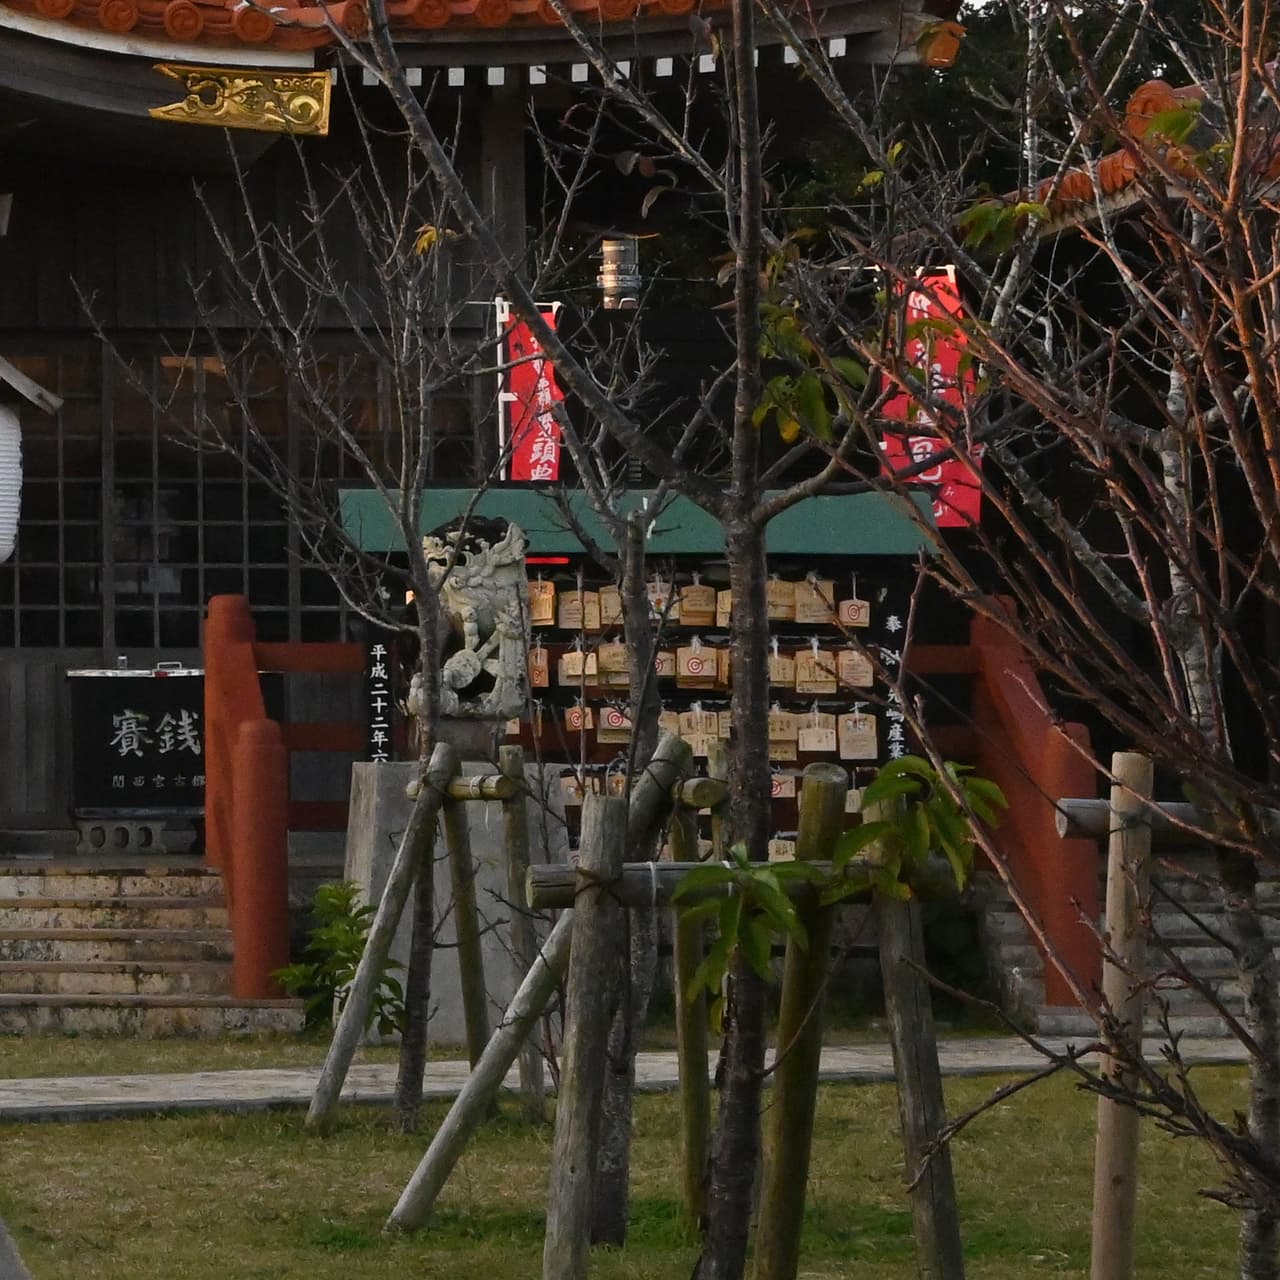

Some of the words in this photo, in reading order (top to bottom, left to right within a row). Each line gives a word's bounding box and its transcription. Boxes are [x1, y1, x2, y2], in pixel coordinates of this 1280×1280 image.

[109, 708, 202, 758] 賽銭
[370, 643, 389, 763] 平成二十二年六
